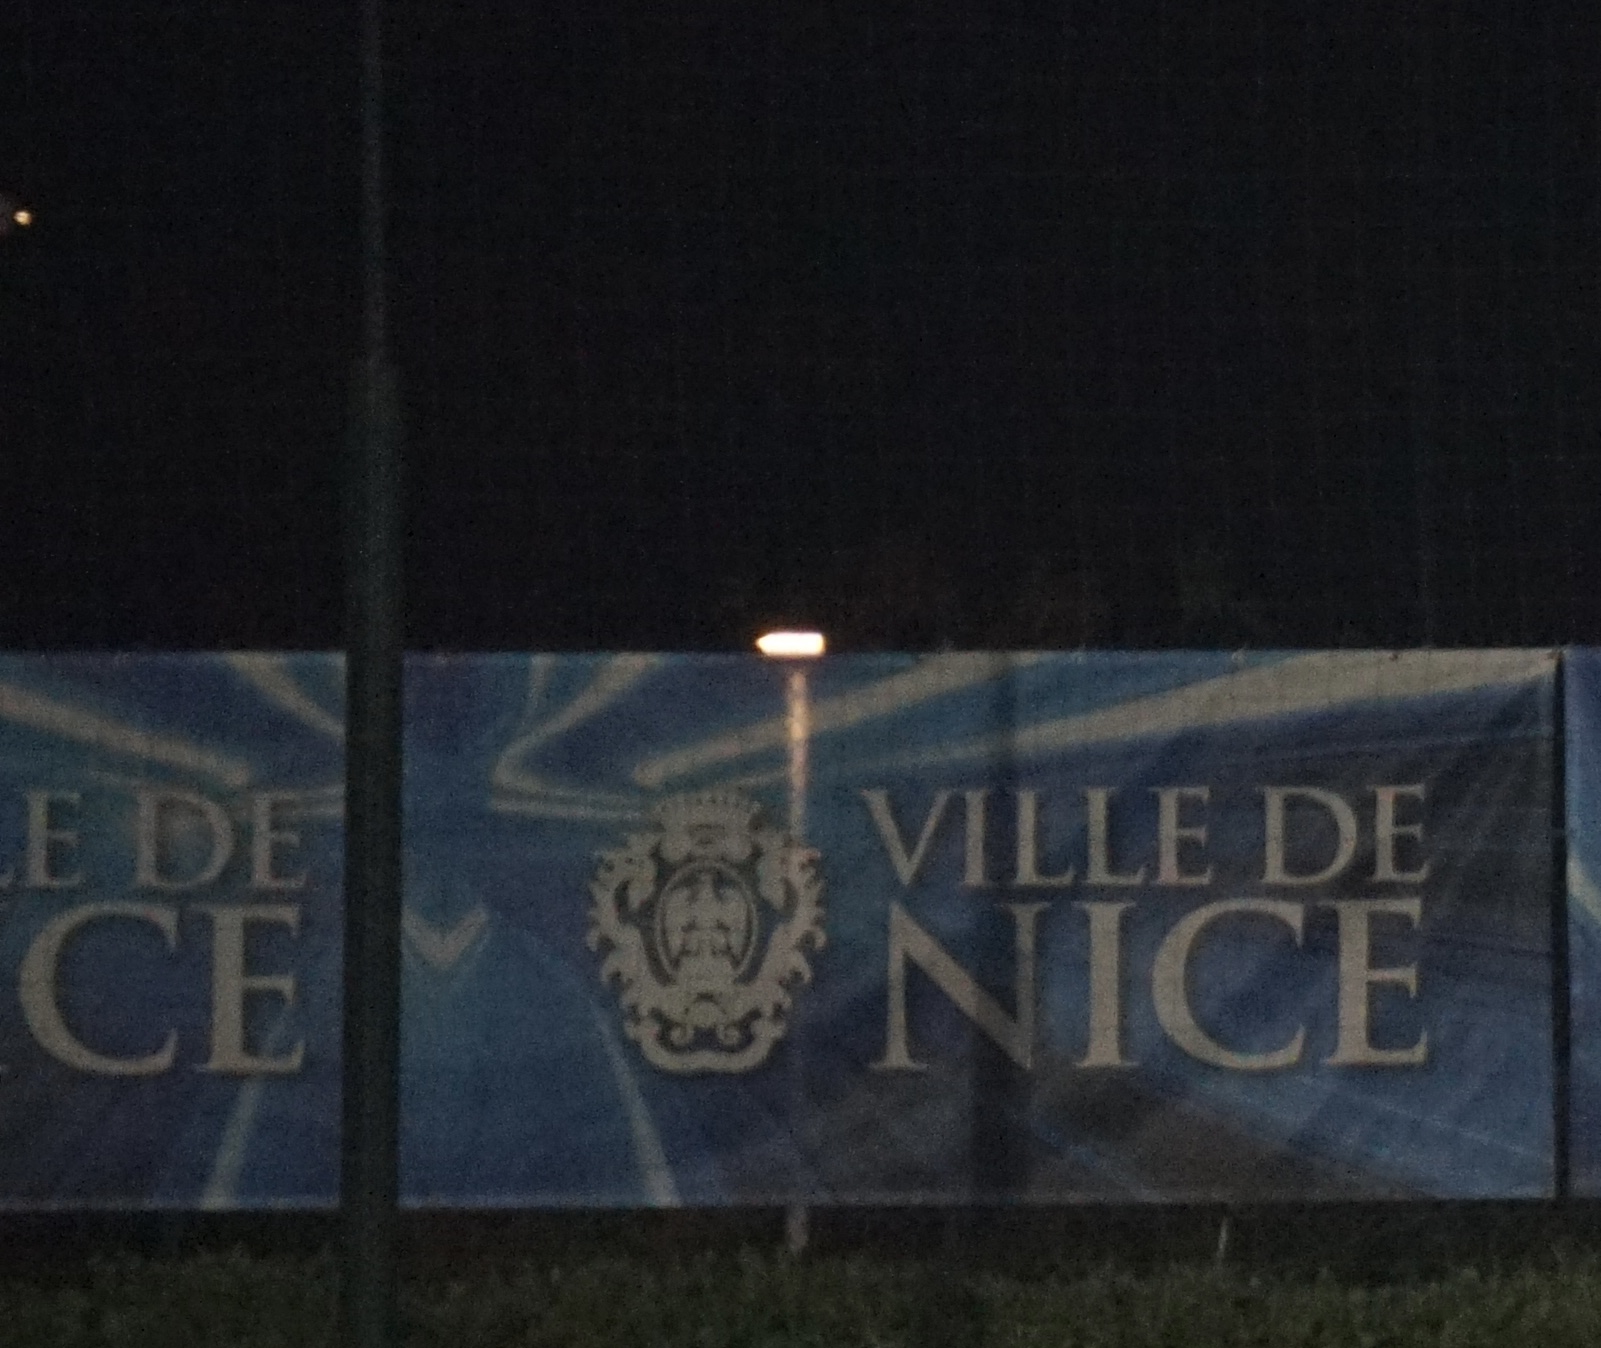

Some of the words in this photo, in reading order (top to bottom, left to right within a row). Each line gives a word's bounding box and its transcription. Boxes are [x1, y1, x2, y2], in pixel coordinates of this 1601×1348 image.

[0, 792, 85, 889] E
[135, 791, 309, 890] DE
[861, 786, 1215, 888] VILLE
[1258, 784, 1430, 886] DE
[868, 898, 1429, 1070] NICE
